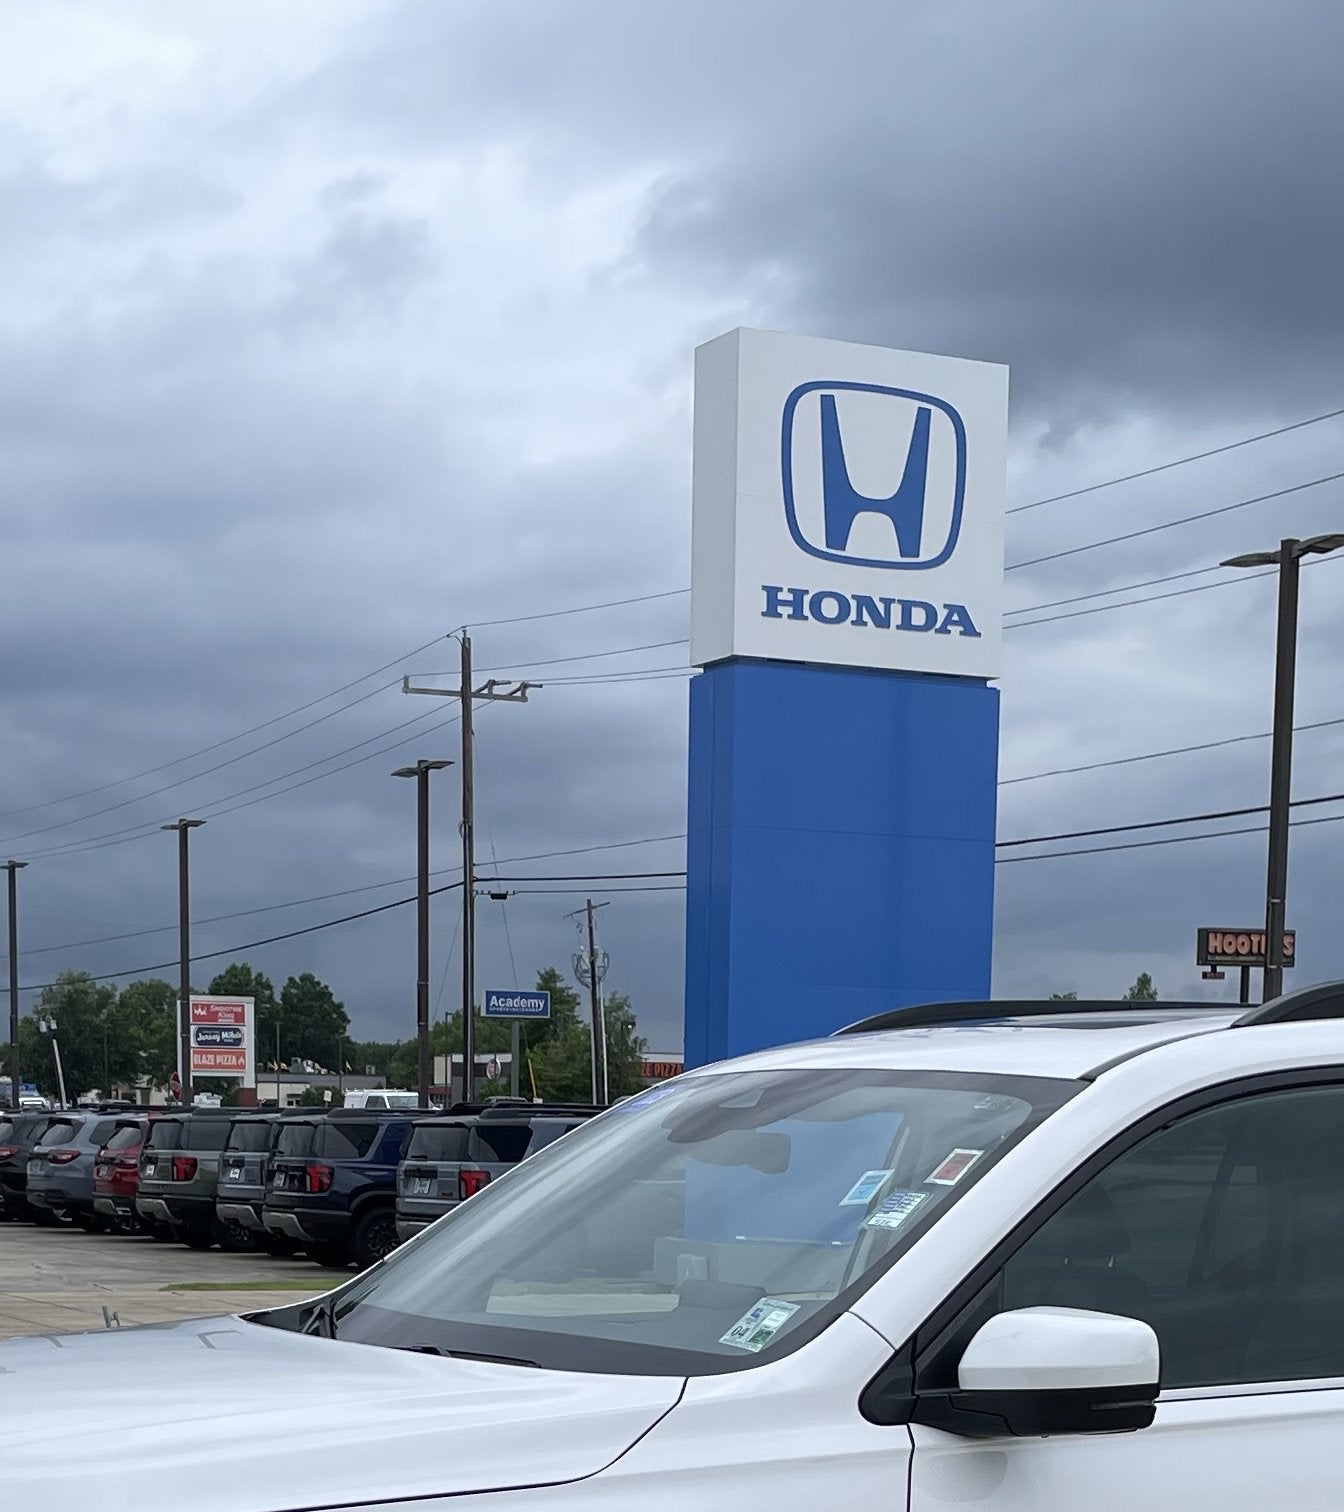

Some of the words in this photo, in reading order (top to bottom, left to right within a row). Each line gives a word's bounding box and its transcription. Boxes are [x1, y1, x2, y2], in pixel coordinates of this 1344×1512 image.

[760, 584, 982, 638] HONDA
[489, 994, 546, 1012] Academy
[216, 1054, 237, 1066] PIZZA
